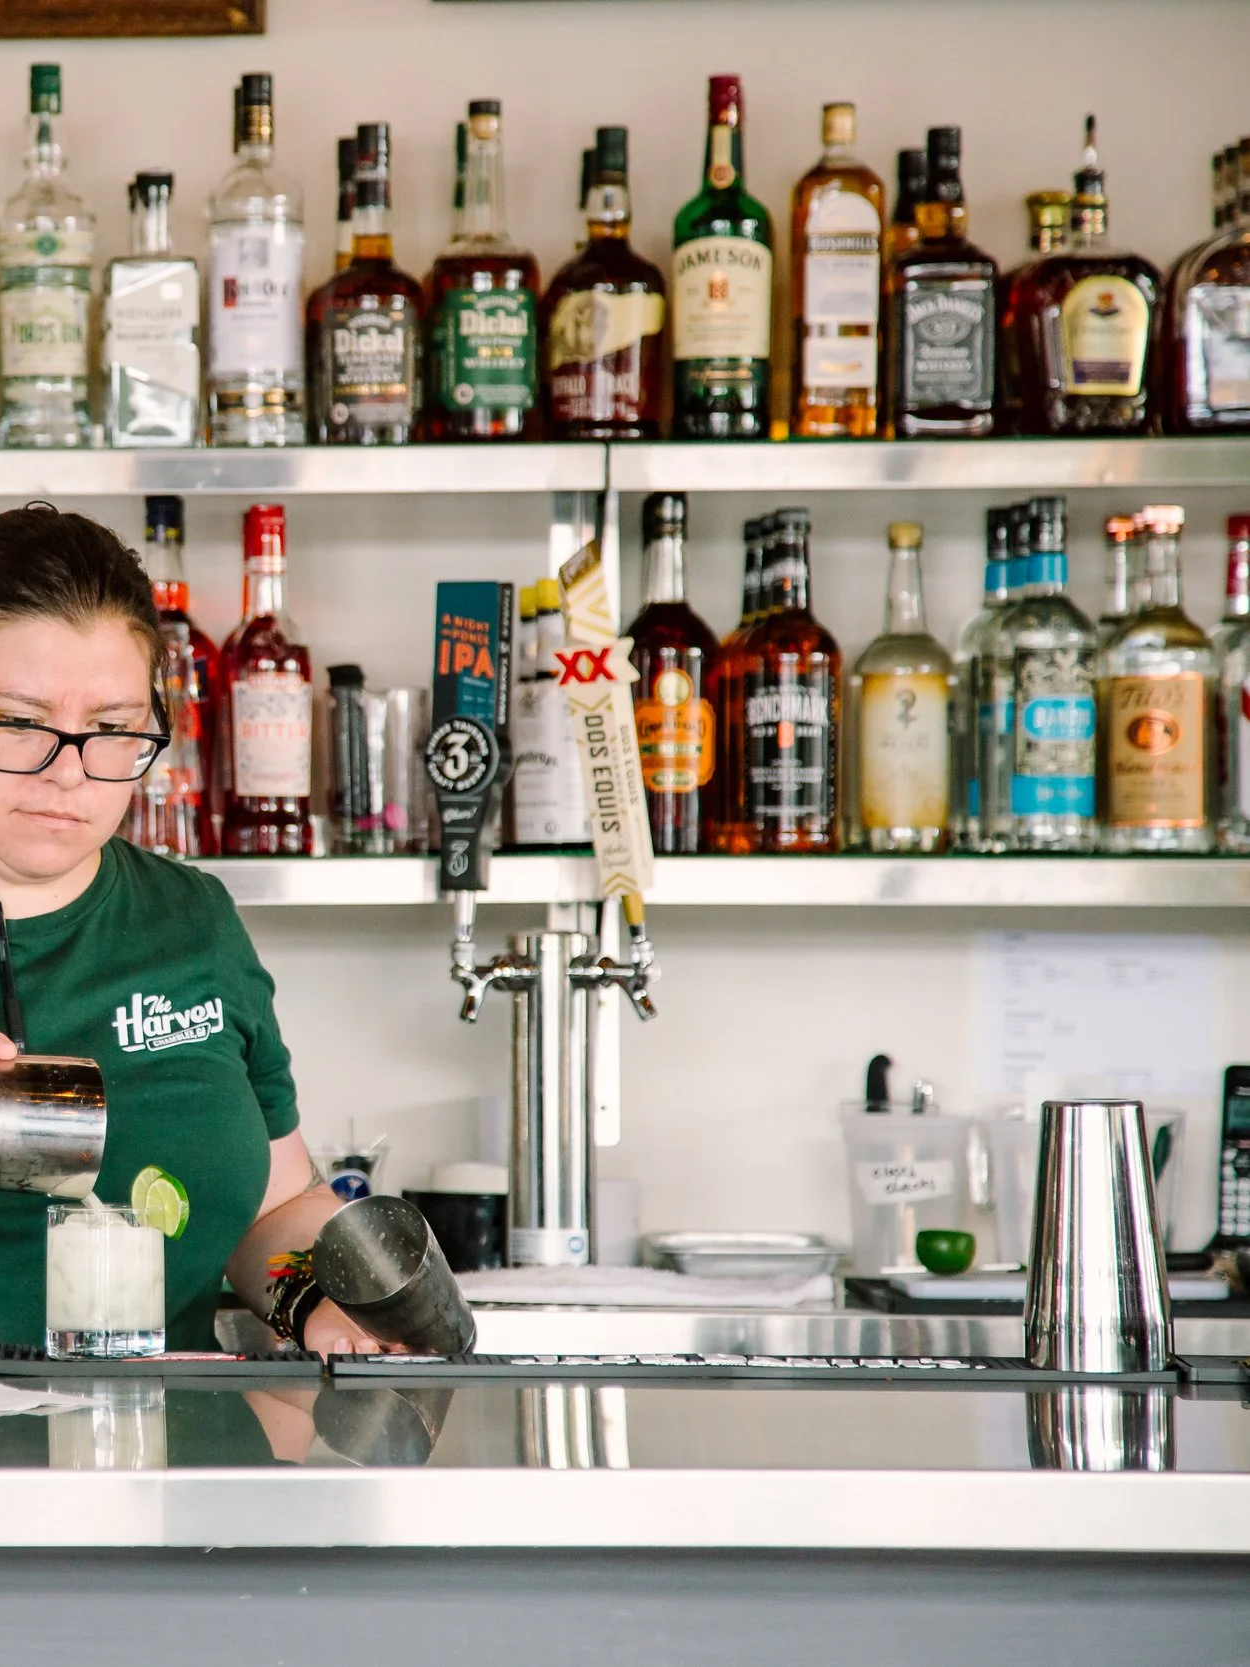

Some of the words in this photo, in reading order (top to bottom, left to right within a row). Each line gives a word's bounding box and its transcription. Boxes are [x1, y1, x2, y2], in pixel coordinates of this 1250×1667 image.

[678, 246, 763, 274] JAMESON
[334, 328, 405, 355] Dickel
[459, 310, 528, 335] Dickel
[438, 639, 494, 679] IPA
[555, 647, 614, 686] XX
[584, 714, 608, 758] DOS
[442, 732, 471, 780] 3
[591, 768, 620, 834] EQUIS
[112, 992, 224, 1048] Harvey
[143, 994, 173, 1016] The
